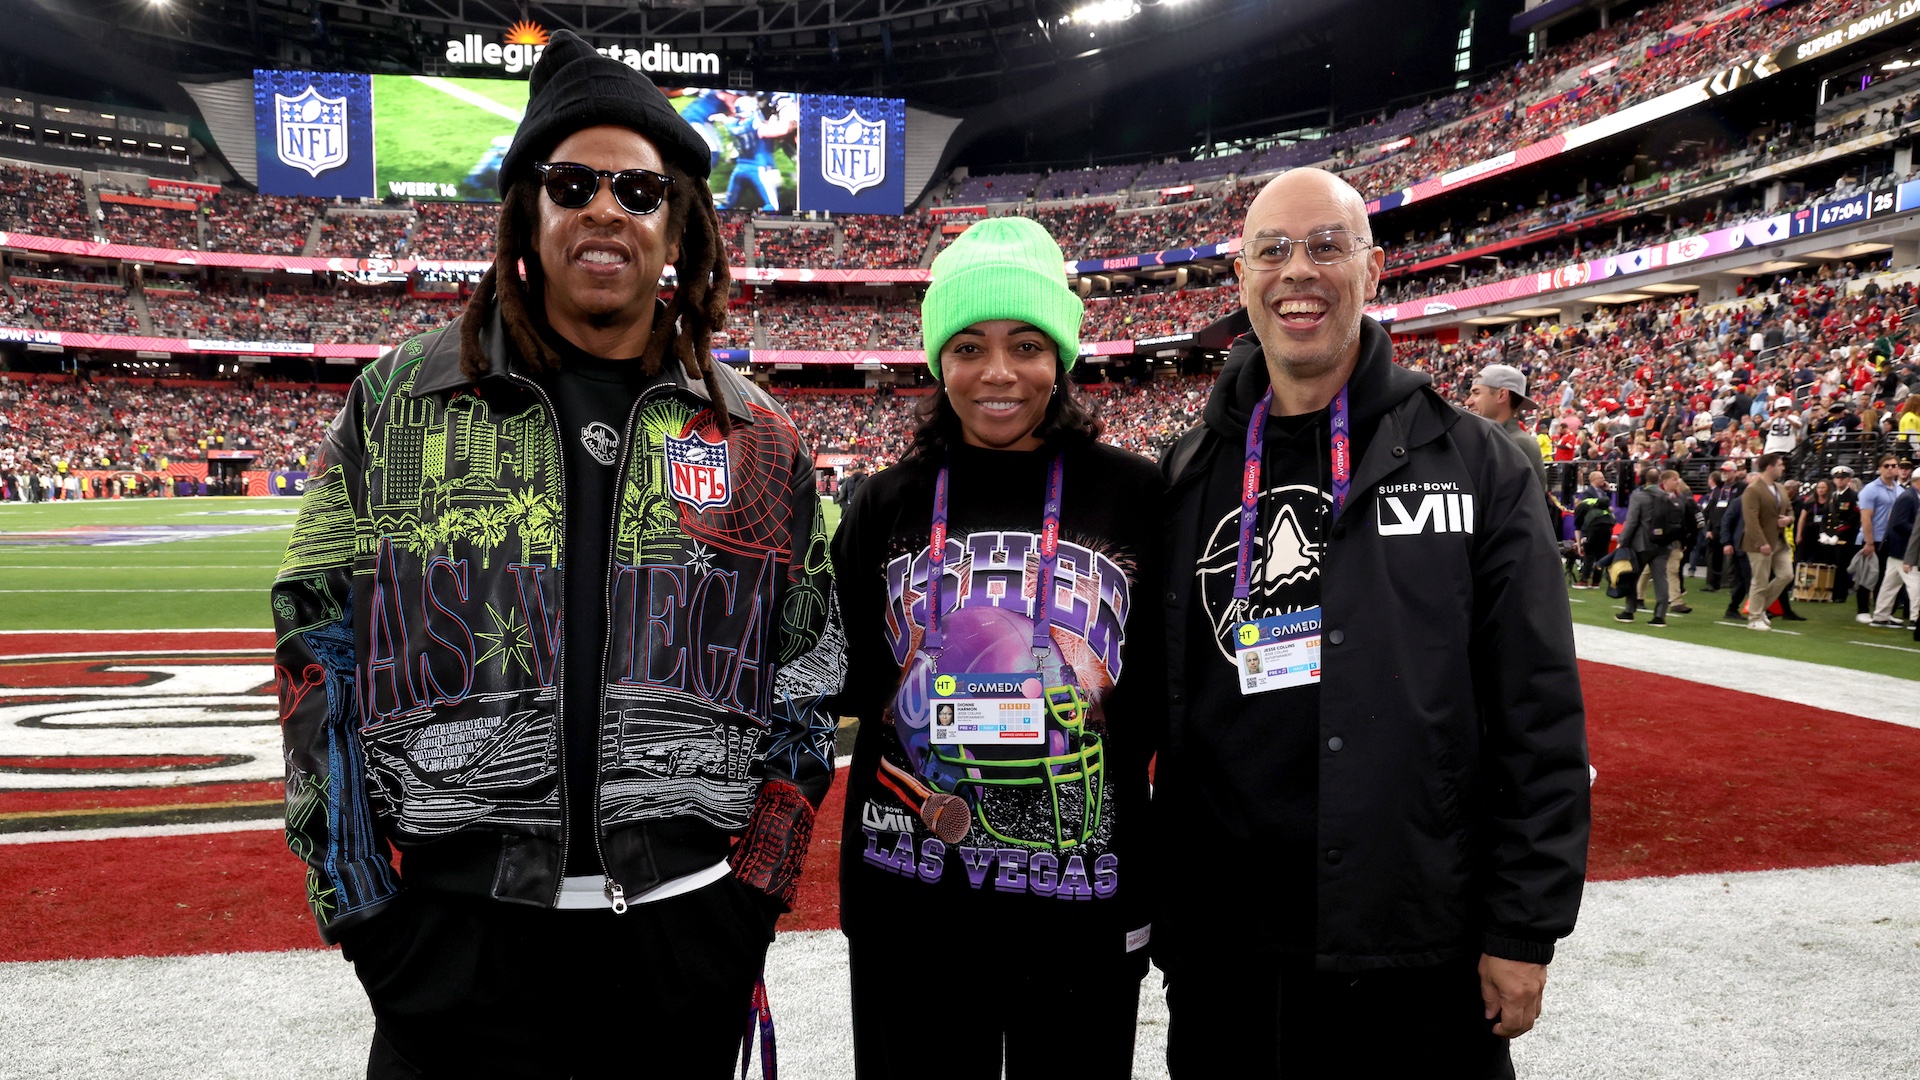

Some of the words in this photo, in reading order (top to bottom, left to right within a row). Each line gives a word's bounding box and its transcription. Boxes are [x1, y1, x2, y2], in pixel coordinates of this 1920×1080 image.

[1797, 29, 1843, 59] SUPER
[1848, 8, 1894, 40] BOWL
[287, 127, 338, 161] NFL
[831, 148, 876, 180] NFL
[389, 181, 437, 197] WEEK
[439, 184, 457, 197] 16
[1873, 193, 1894, 212] 25
[1820, 200, 1864, 224] 47:04
[1103, 256, 1138, 269] #SBLVIII
[587, 440, 617, 461] MONCLER
[672, 462, 725, 502] NFL
[1247, 465, 1255, 499] GAMEDAY
[1379, 483, 1417, 494] SUPER
[1423, 482, 1459, 491] BOWL
[1377, 494, 1473, 536] LVIII
[1046, 524, 1054, 552] GAMEDAY
[487, 551, 775, 727] VEGA
[1239, 630, 1251, 640] HT
[1277, 643, 1295, 651] COLLINS
[968, 683, 1022, 693] GAMEDA
[862, 801, 914, 833] LVIII
[862, 827, 945, 884] LAS
[959, 846, 1118, 900] VEGAS
